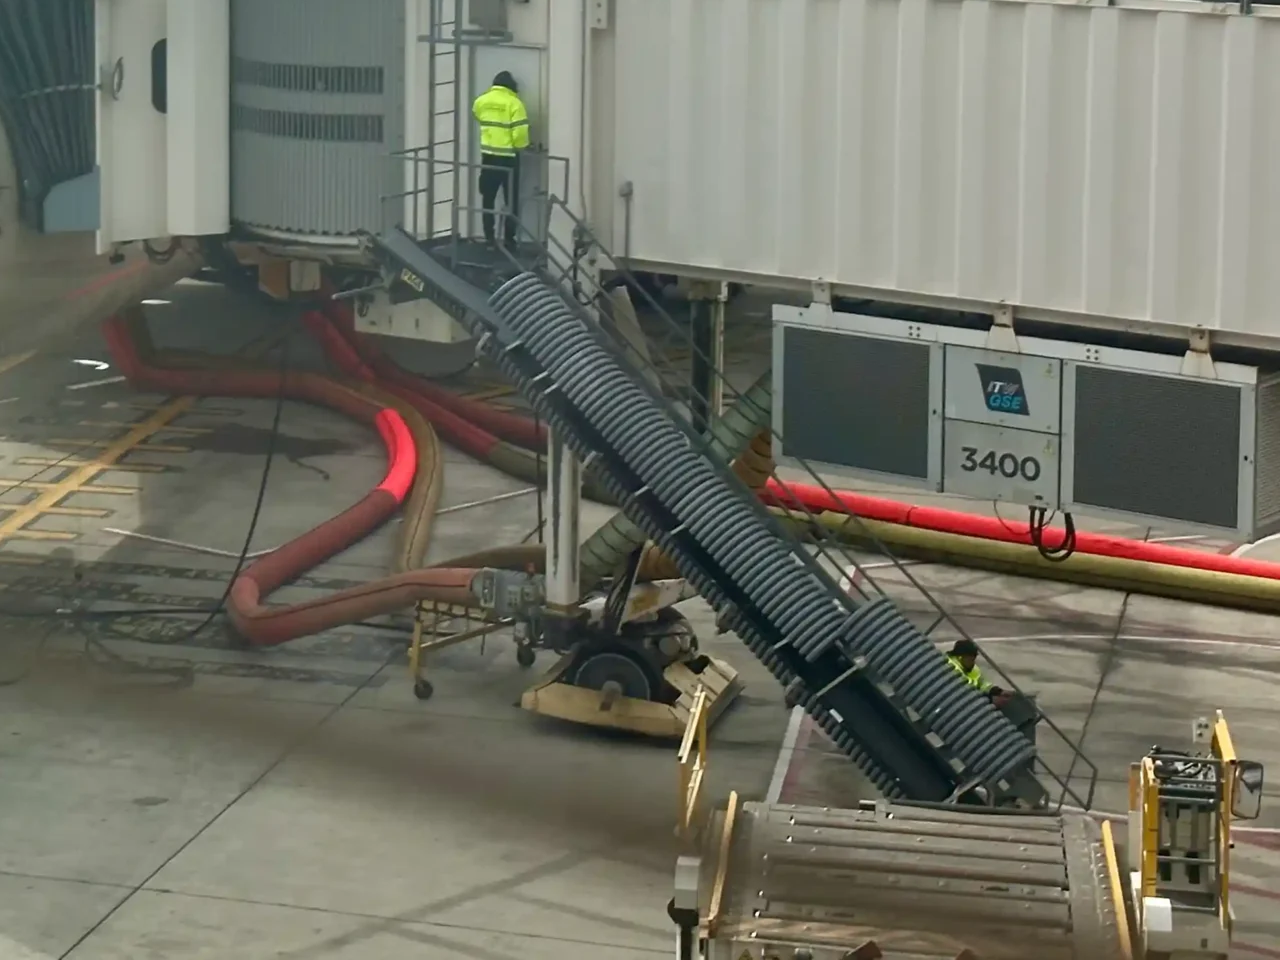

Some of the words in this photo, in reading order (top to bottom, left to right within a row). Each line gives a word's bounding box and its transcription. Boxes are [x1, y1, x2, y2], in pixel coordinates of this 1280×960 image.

[986, 380, 1020, 396] ITW
[989, 394, 1023, 410] GSE
[960, 446, 1041, 482] 3400
